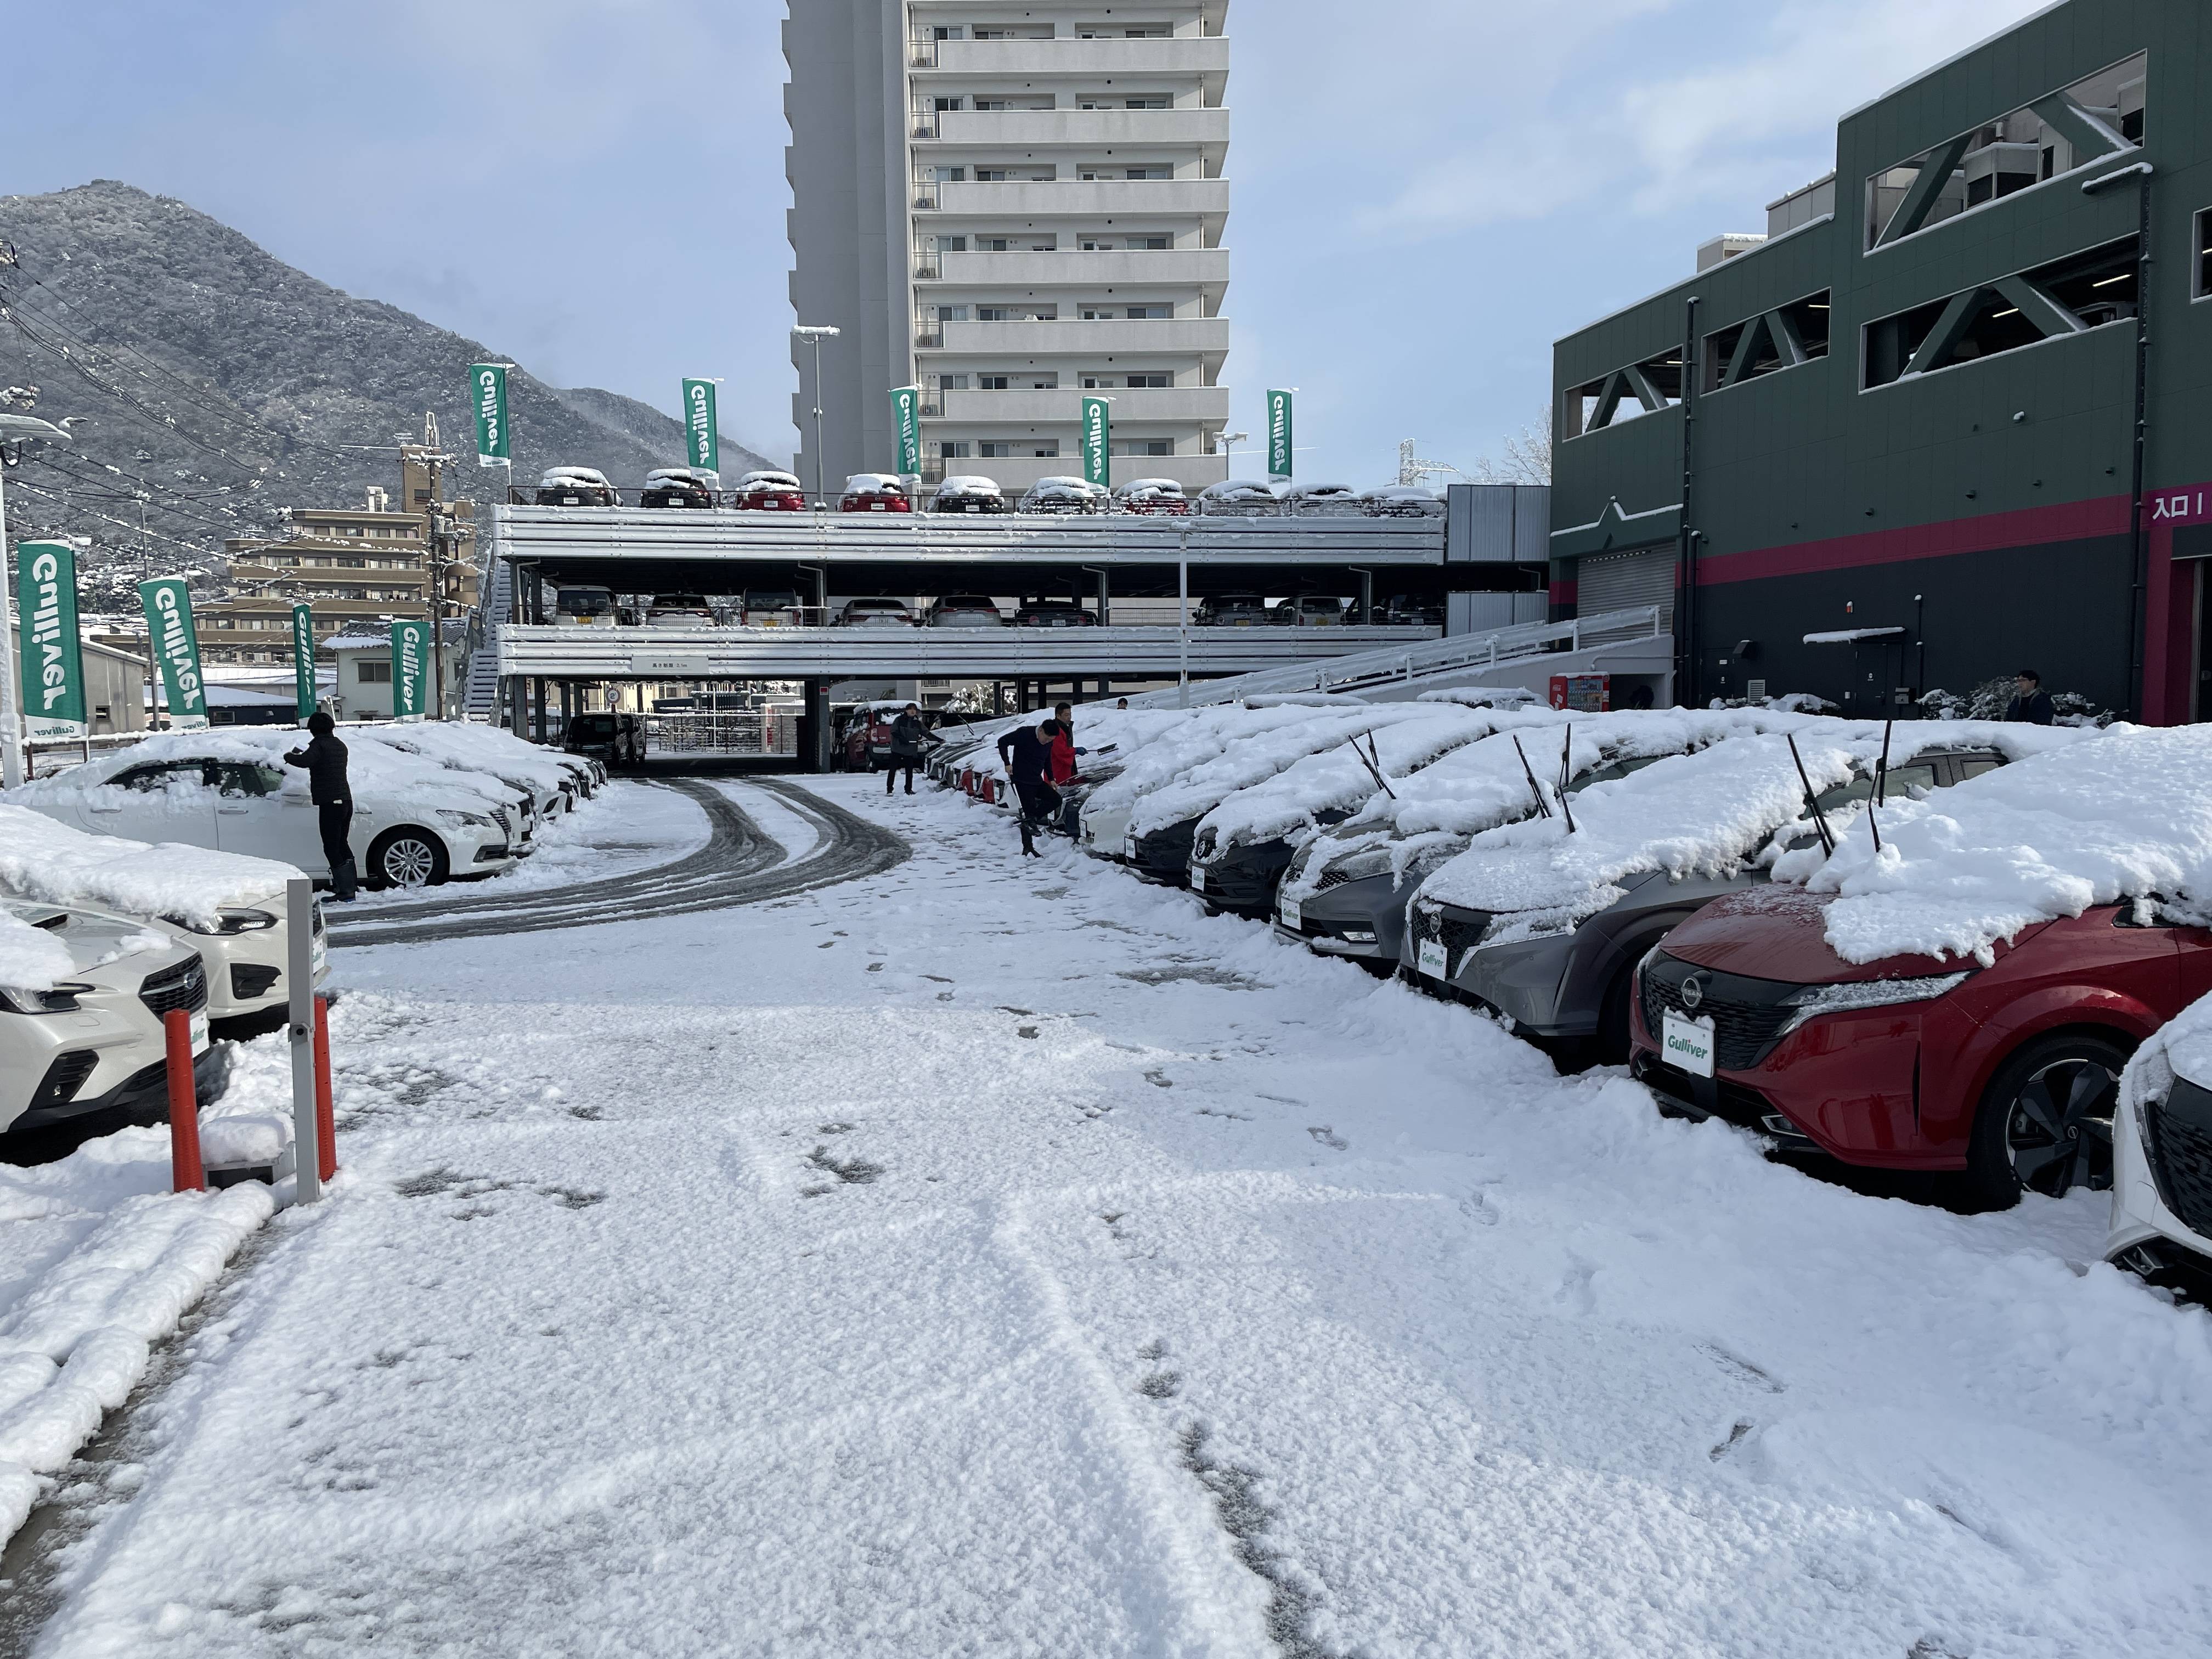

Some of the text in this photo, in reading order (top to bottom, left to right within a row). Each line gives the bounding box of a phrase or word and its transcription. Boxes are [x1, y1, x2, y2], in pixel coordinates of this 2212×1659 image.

[2152, 495, 2188, 520] 入口
[403, 627, 420, 711] Gulliver
[1422, 952, 1444, 967] Gulliver
[1668, 1035, 1708, 1059] Gulliver
